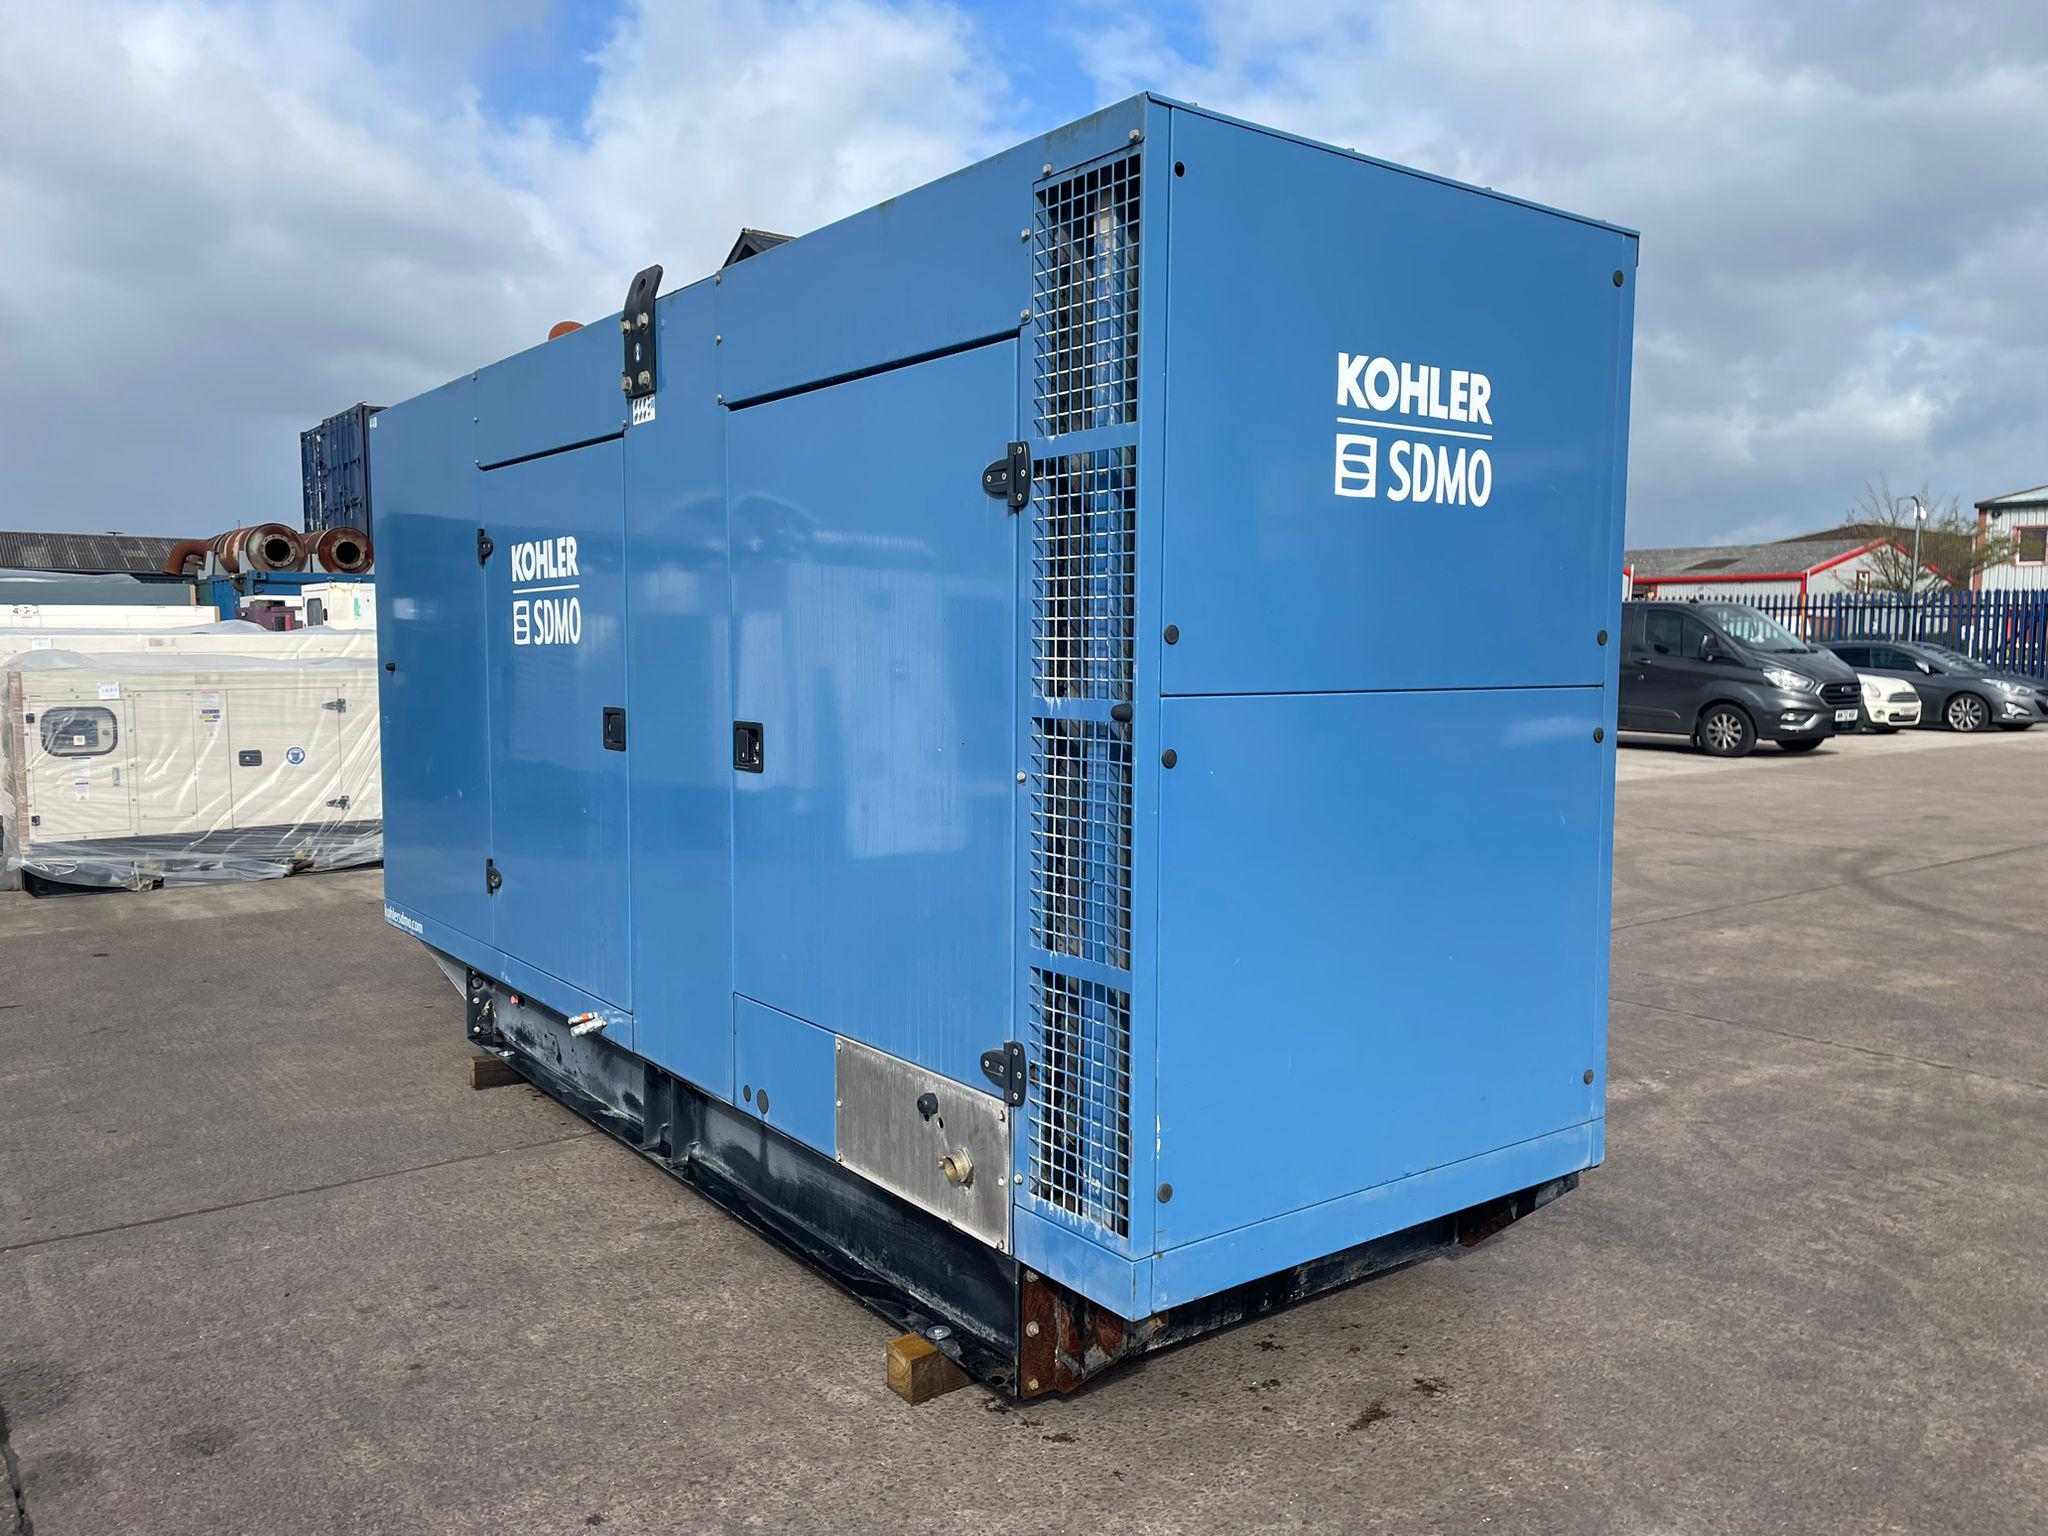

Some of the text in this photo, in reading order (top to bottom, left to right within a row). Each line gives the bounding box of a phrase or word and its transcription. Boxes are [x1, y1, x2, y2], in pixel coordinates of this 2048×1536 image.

[1336, 351, 1493, 425] KOHLER
[1386, 439, 1493, 508] SDMO
[511, 535, 580, 582] KOHLER
[533, 596, 581, 646] SDMO
